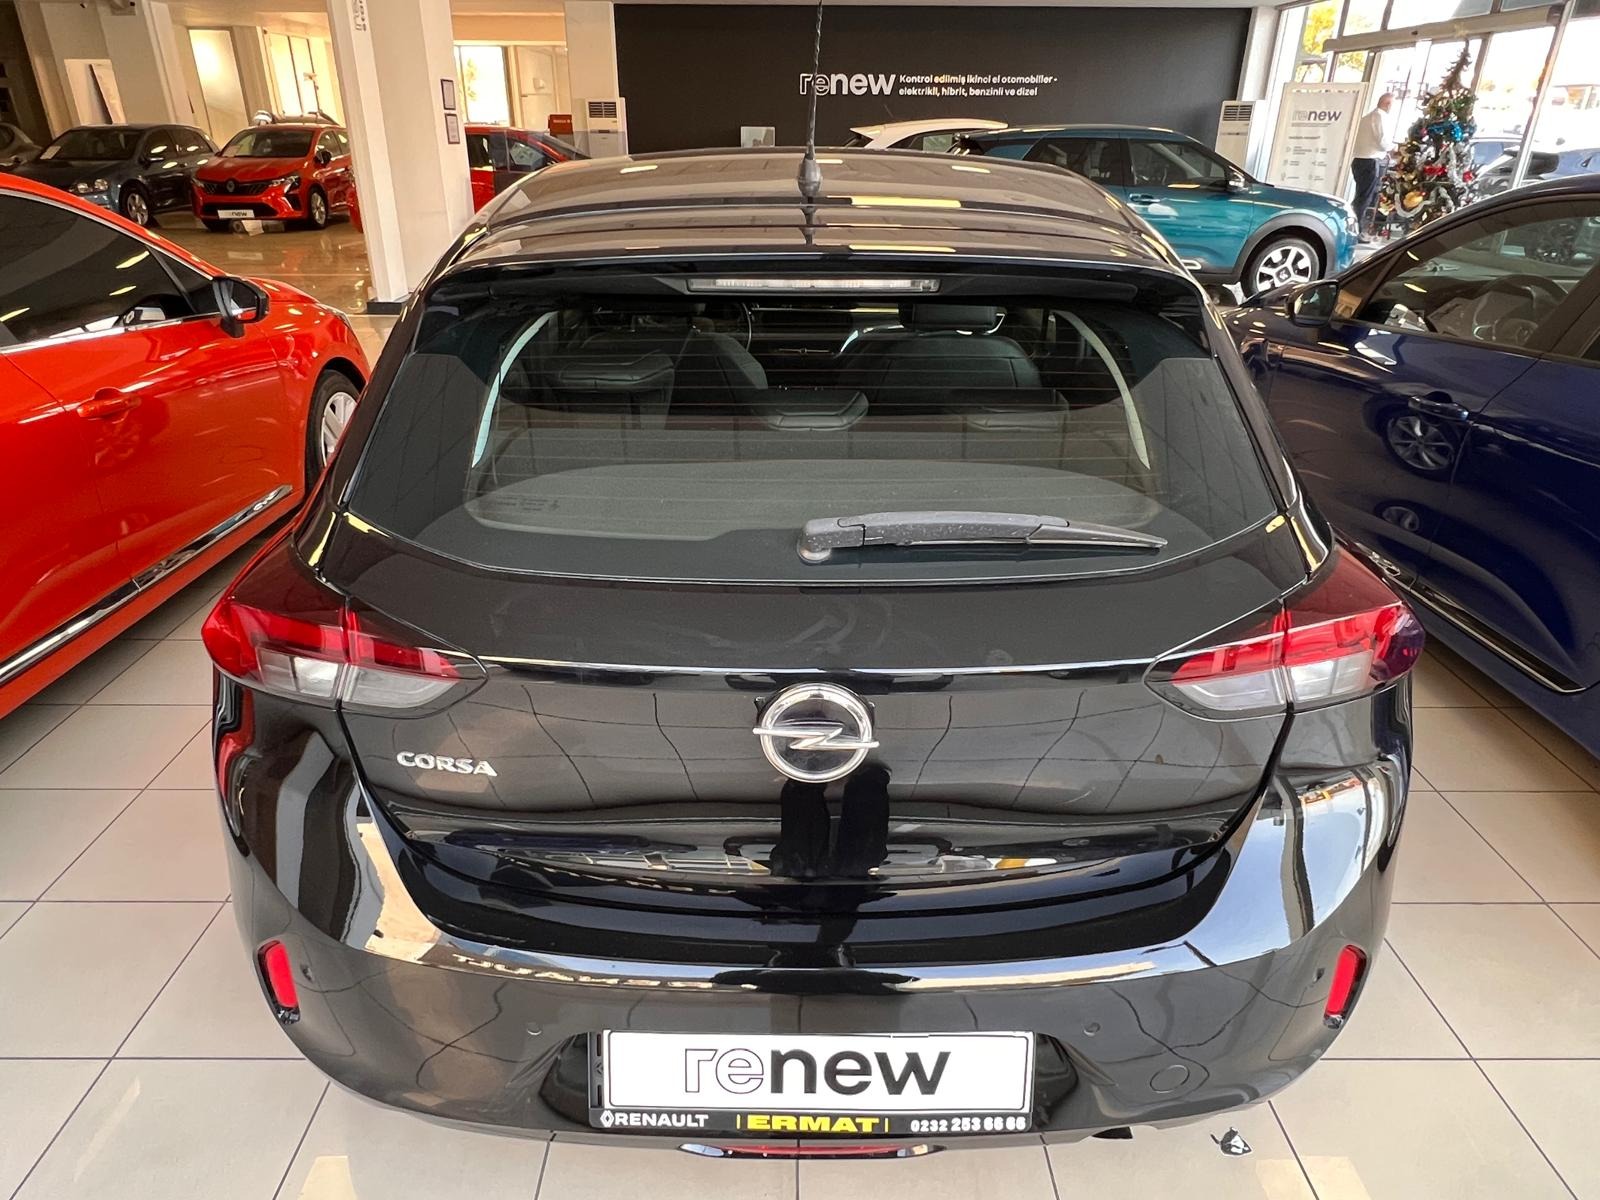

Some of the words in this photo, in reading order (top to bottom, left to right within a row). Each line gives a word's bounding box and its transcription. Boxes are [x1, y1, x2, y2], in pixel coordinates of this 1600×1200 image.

[799, 73, 896, 96] renew
[900, 74, 932, 84] Kontrol
[967, 74, 991, 84] ikinci
[992, 74, 1000, 84] el
[1001, 74, 1053, 84] otomobiller
[942, 87, 967, 97] hibrit,
[969, 87, 1003, 96] benzinli
[1016, 86, 1038, 96] dizel
[396, 751, 498, 777] CORSA
[684, 1047, 951, 1096] renew
[615, 1112, 709, 1128] RENAULT
[747, 1114, 879, 1132] ERMAT
[910, 1119, 948, 1132] 0232
